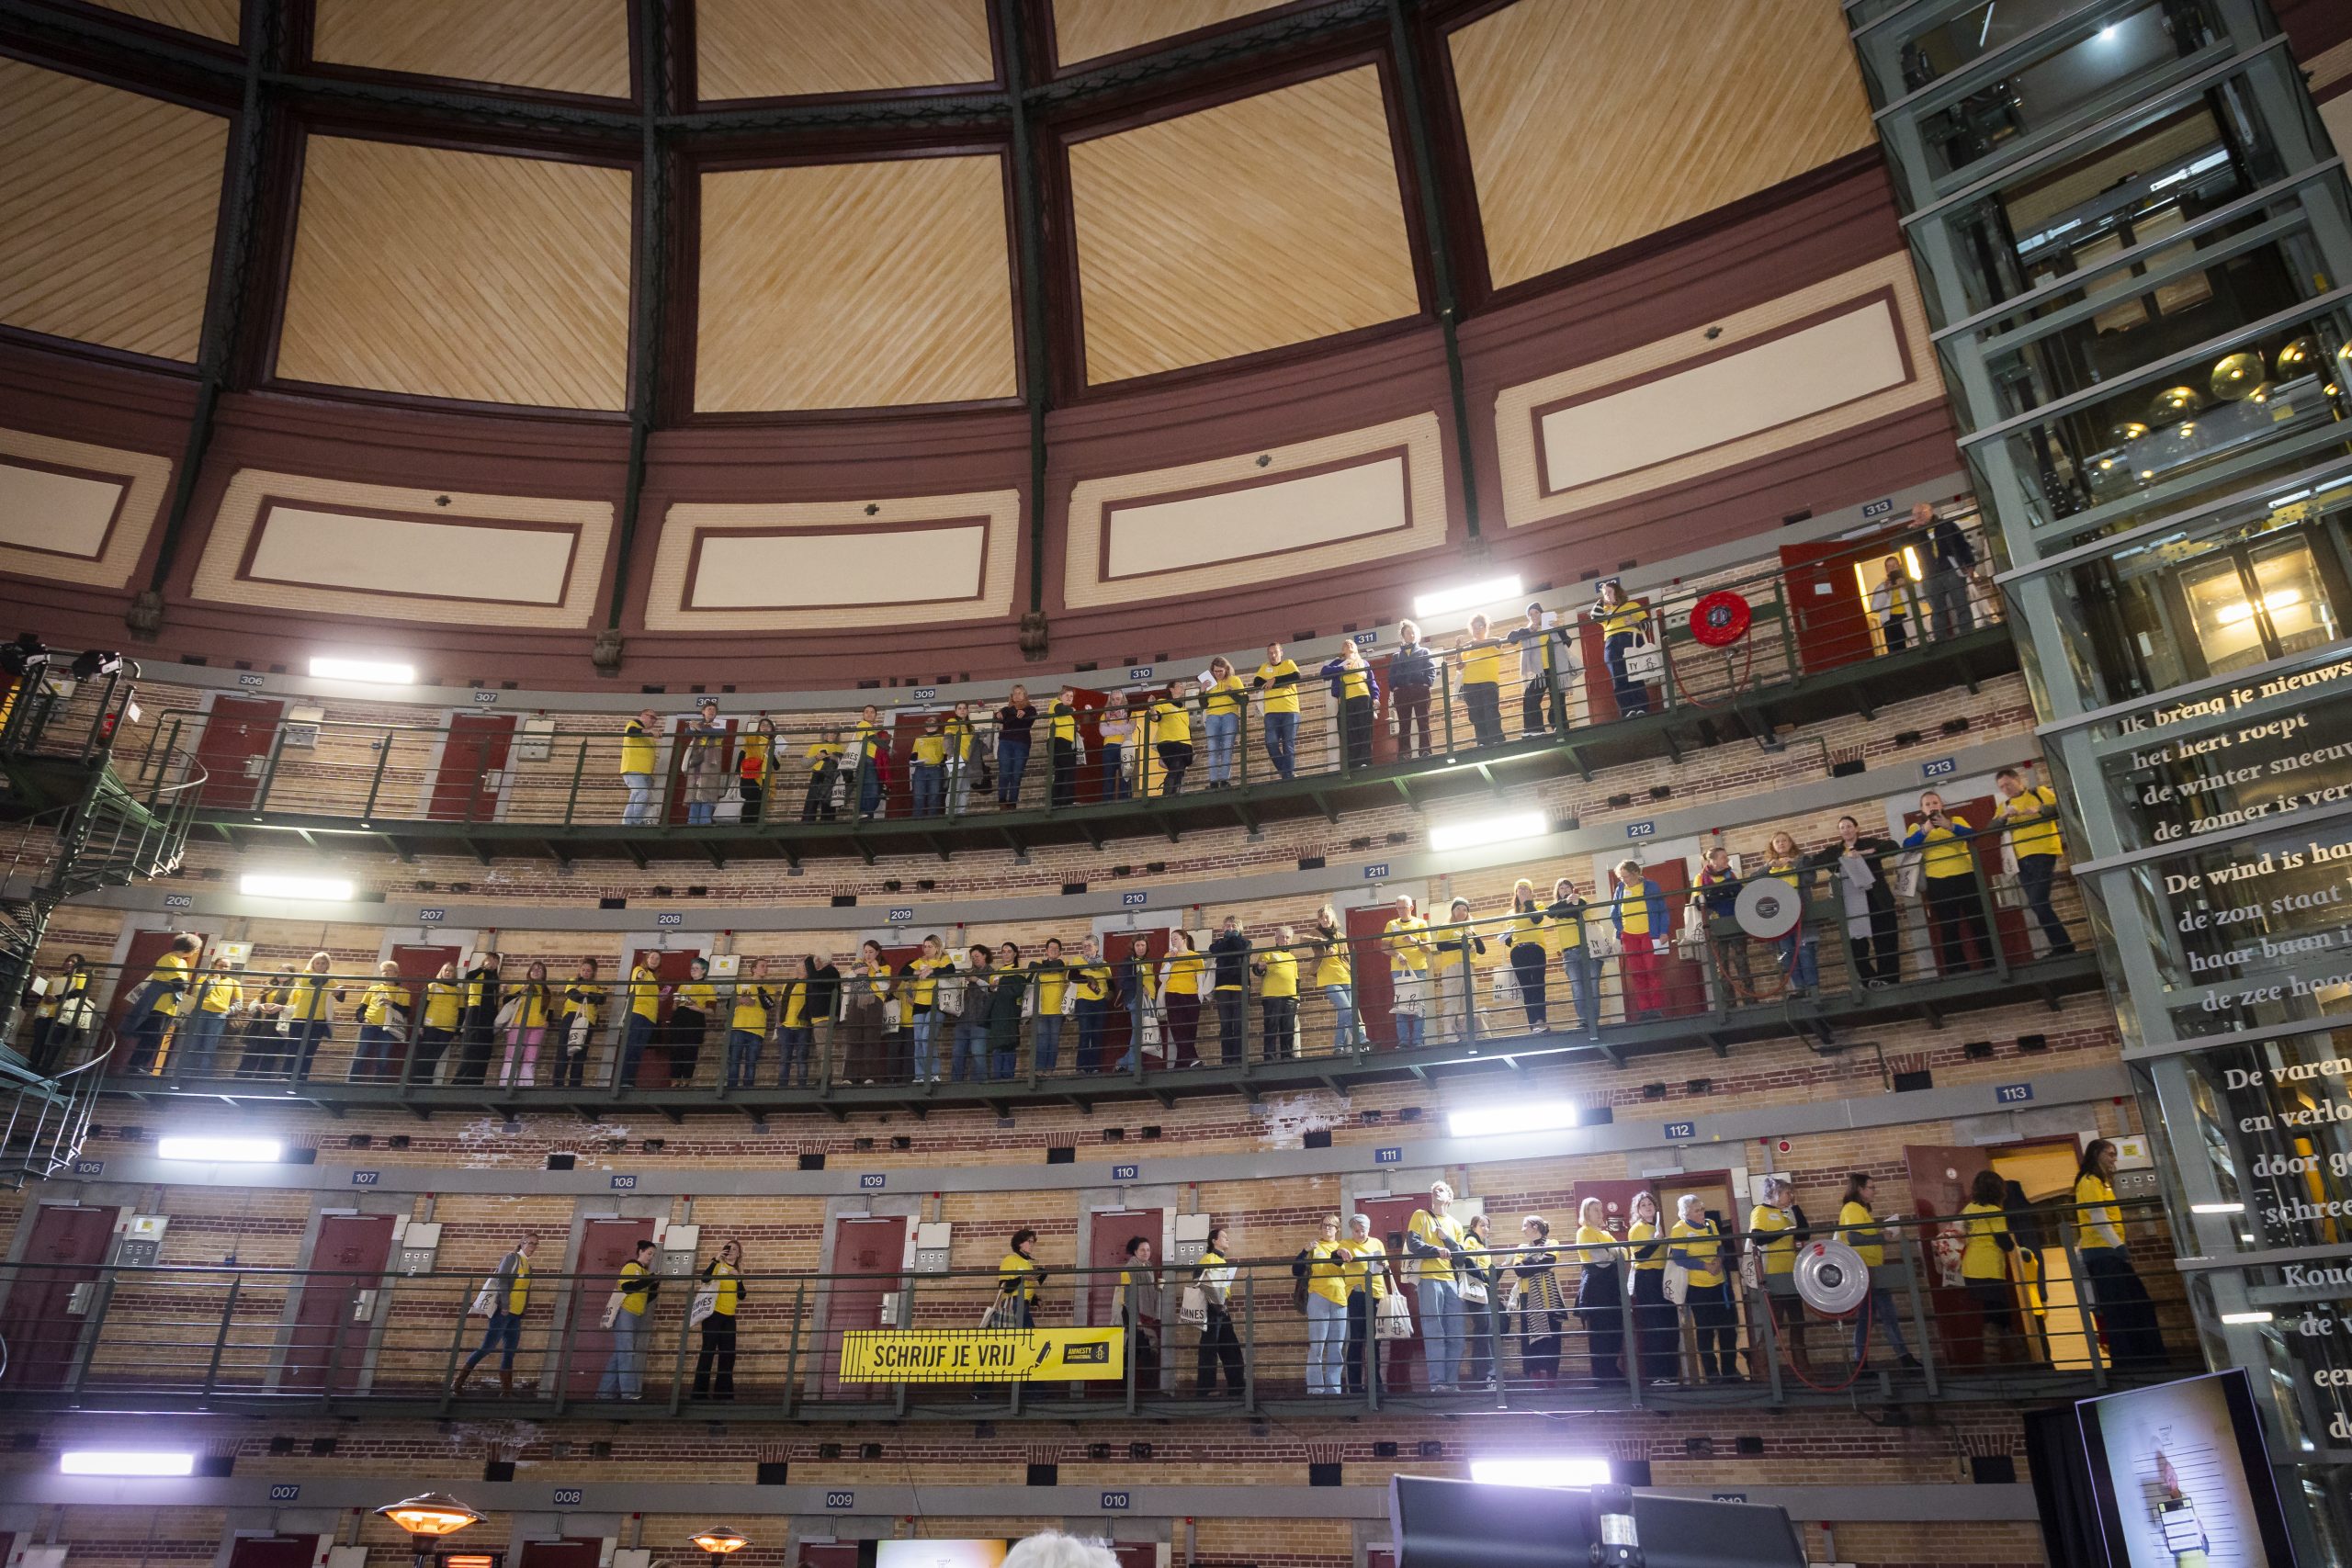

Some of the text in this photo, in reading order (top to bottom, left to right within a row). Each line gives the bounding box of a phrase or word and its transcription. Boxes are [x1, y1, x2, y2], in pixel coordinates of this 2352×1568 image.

[1866, 502, 1890, 514] 313
[1358, 634, 1374, 644] 311
[1133, 669, 1150, 678] 310
[241, 675, 264, 686] 306
[476, 693, 498, 702] 307
[915, 690, 934, 699] 309
[2120, 715, 2149, 736] Ik
[2231, 688, 2254, 709] je
[2259, 660, 2352, 698] nieuws
[2130, 711, 2310, 771] het hert roept
[1927, 761, 1951, 775] 213
[2143, 784, 2173, 806] de
[2177, 763, 2262, 797] winter
[2154, 820, 2183, 841] de
[2188, 801, 2270, 834] zomer
[2276, 795, 2300, 813] is
[1631, 824, 1652, 836] 212
[1369, 866, 1385, 876] 211
[2164, 874, 2201, 895] De
[2206, 852, 2276, 886] wind
[2280, 851, 2304, 870] is
[166, 896, 190, 906] 206
[1125, 894, 1145, 904] 210
[421, 910, 443, 919] 207
[891, 910, 911, 919] 209
[2178, 911, 2208, 932] de
[2215, 902, 2264, 926] zon
[2271, 885, 2342, 914] staat
[659, 915, 681, 924] 208
[2187, 947, 2254, 973] haar
[2258, 932, 2334, 958] baan
[2201, 989, 2233, 1012] de
[2239, 985, 2283, 1006] zee
[2223, 1057, 2352, 1090] De varen
[2002, 1087, 2027, 1100] 113
[2239, 1114, 2274, 1134] en
[1669, 1125, 1690, 1137] 112
[1381, 1150, 1396, 1161] 111
[77, 1163, 100, 1173] 106
[2253, 1154, 2320, 1178] door
[356, 1173, 376, 1183] 107
[1116, 1168, 1134, 1178] 110
[614, 1177, 634, 1187] 108
[863, 1176, 883, 1186] 109
[2299, 1311, 2333, 1337] de
[874, 1344, 1015, 1368] SCHRIJF JE VRIJ
[1068, 1347, 1092, 1355] AMNESTY
[272, 1486, 299, 1498] 007
[554, 1491, 581, 1503] 008
[828, 1494, 853, 1506] 009
[1103, 1495, 1126, 1506] 010
